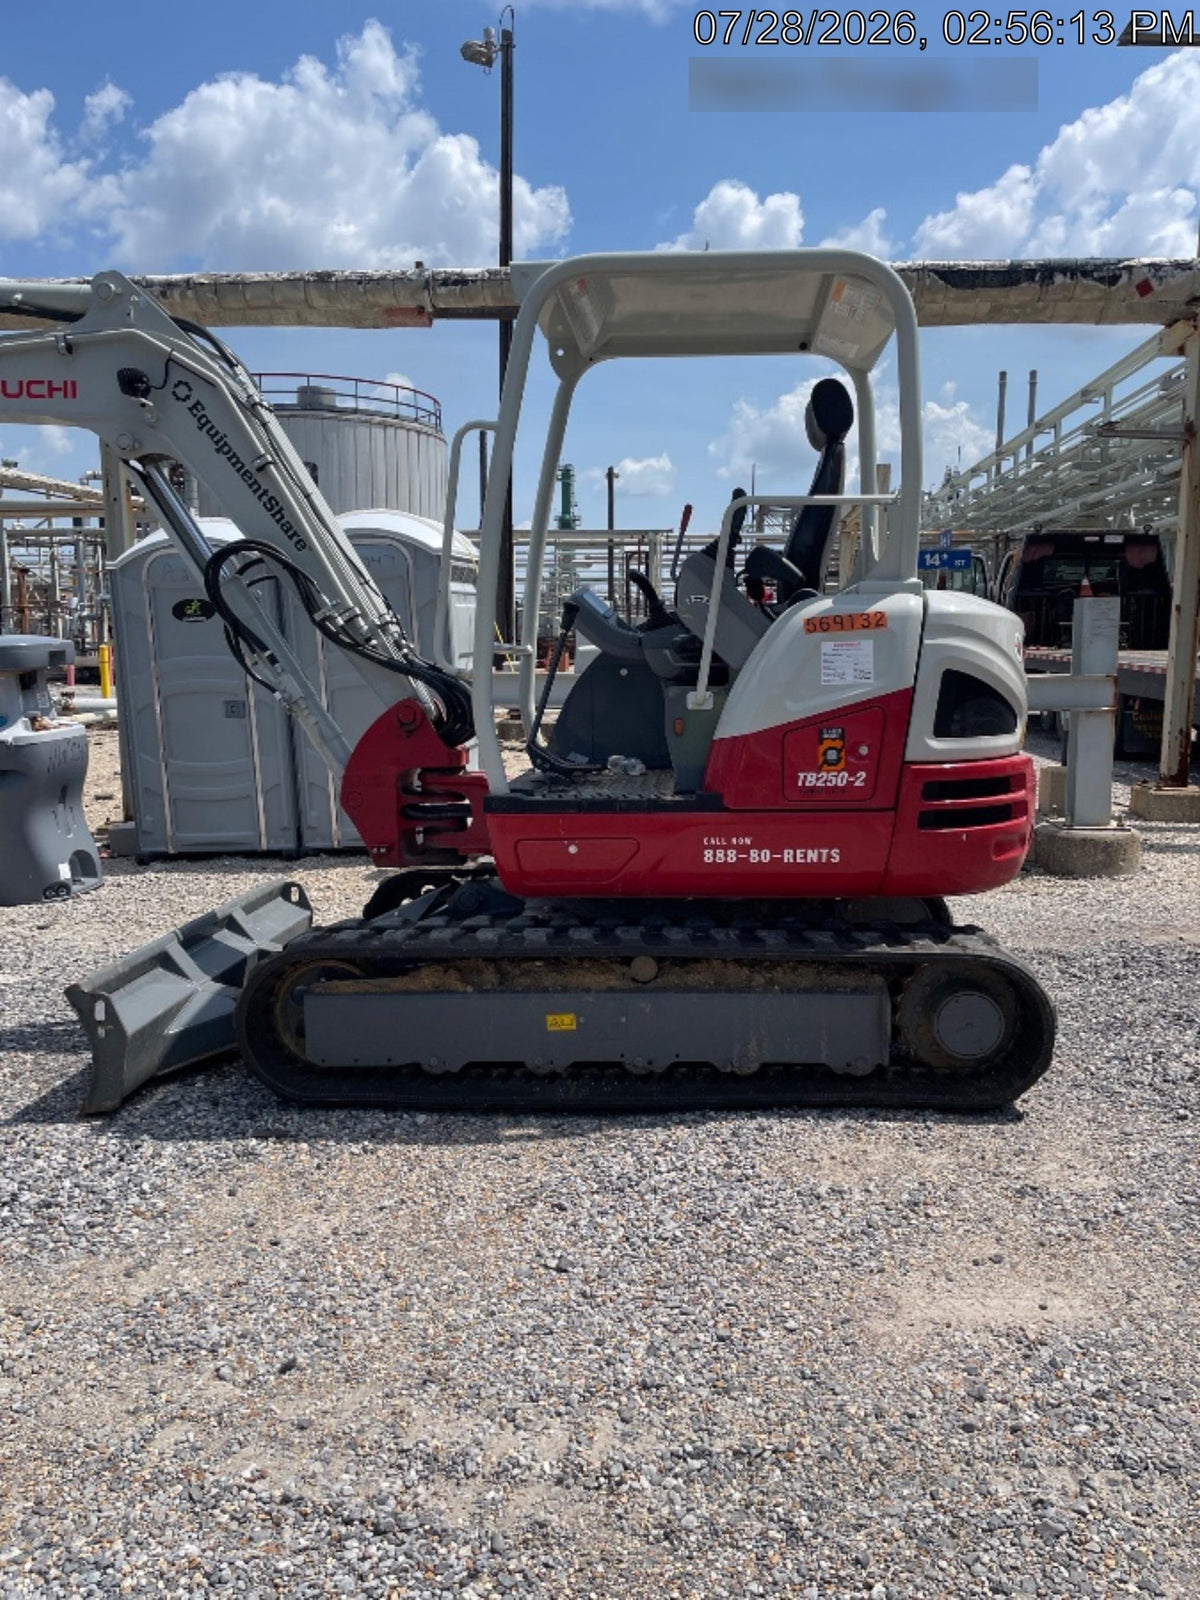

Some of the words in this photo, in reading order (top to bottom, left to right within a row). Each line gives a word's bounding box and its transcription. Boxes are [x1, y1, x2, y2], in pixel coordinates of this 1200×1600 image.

[1, 379, 77, 399] UCHI
[187, 399, 307, 552] EquipmentShare
[806, 611, 886, 633] 569132
[797, 770, 867, 787] TB250-2
[703, 836, 728, 846] CALL
[703, 848, 841, 864] 888-80-RENTS
